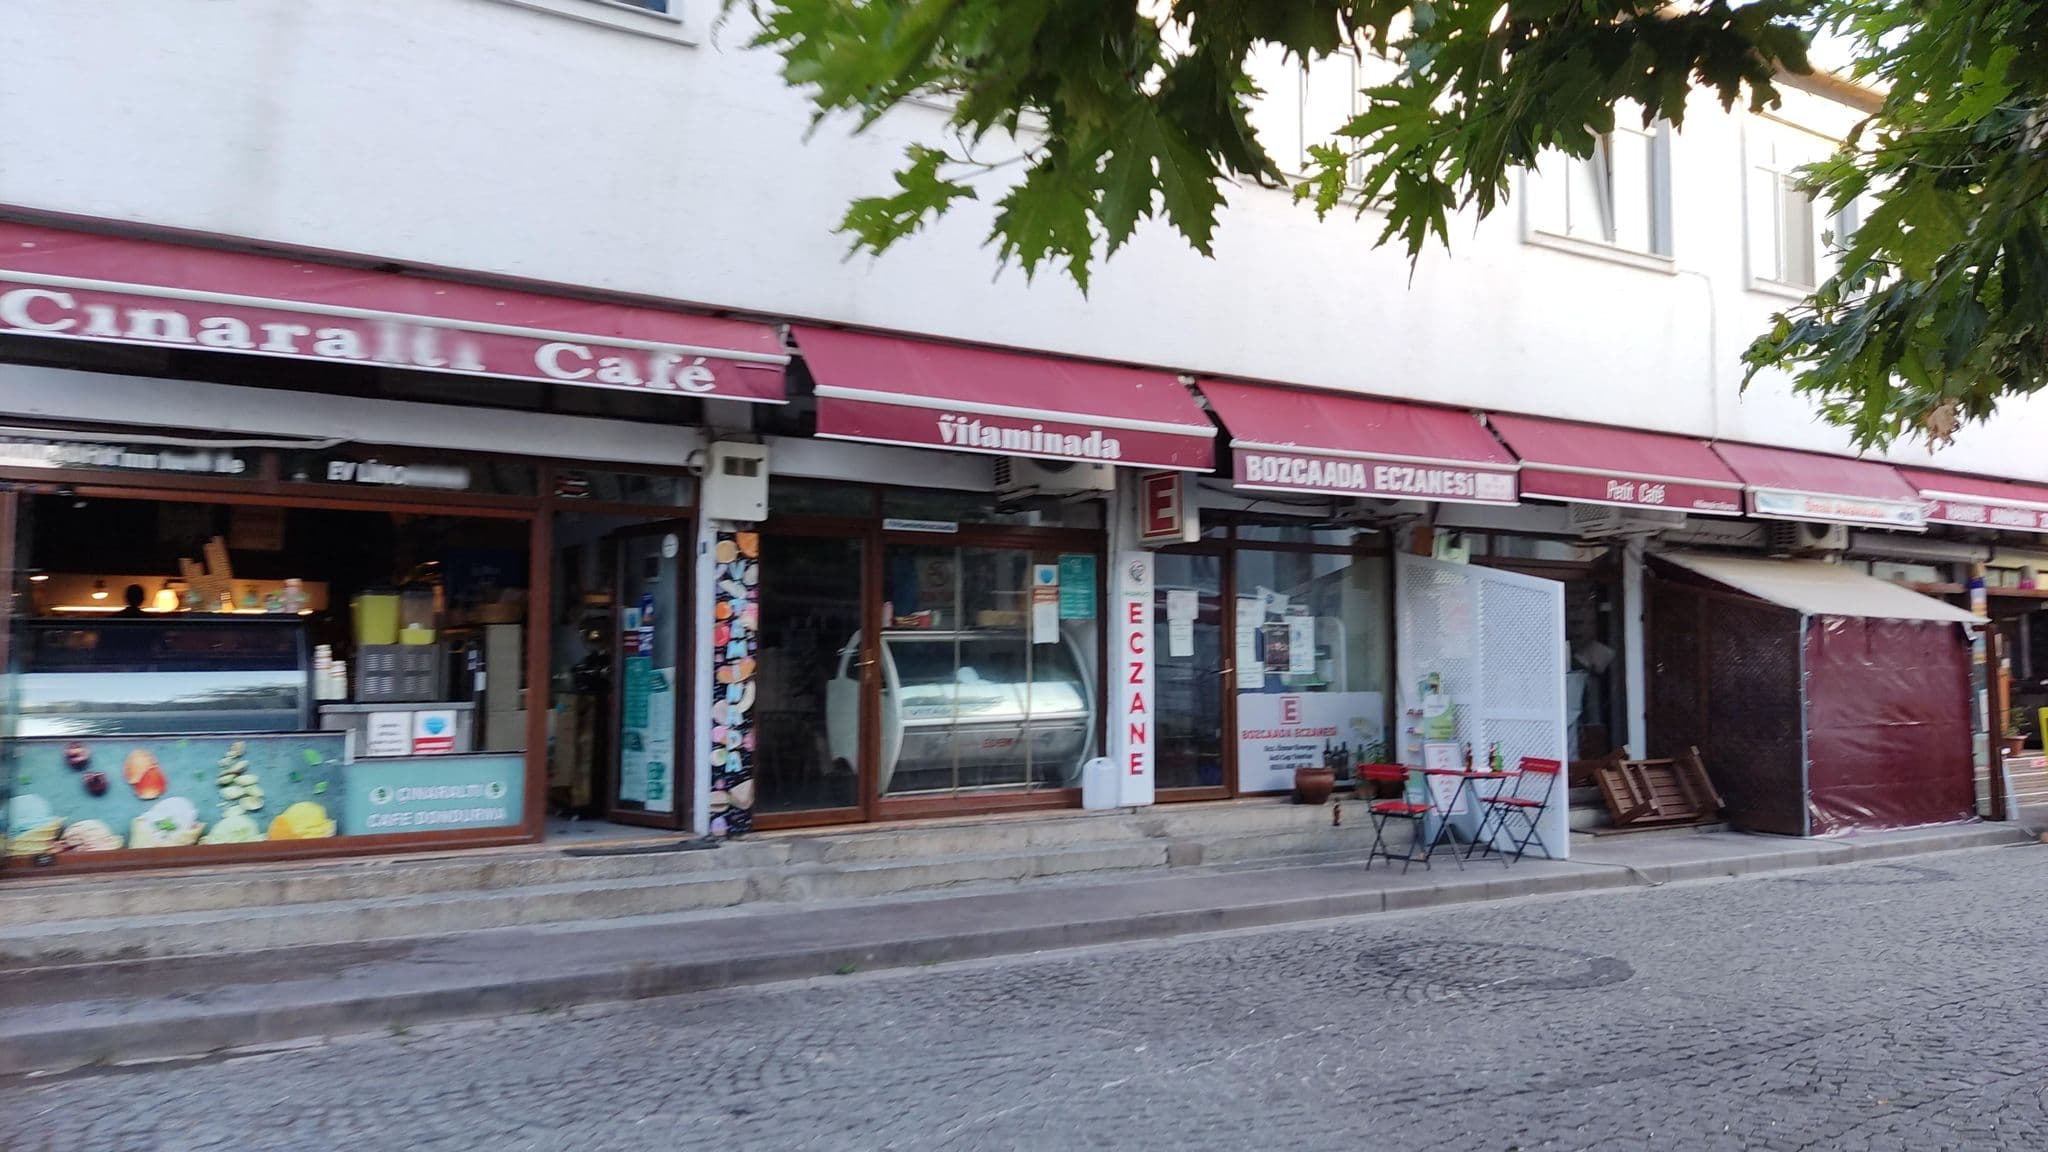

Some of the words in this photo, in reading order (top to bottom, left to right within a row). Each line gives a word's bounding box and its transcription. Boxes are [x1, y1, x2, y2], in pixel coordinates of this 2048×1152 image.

[535, 342, 716, 392] Café
[1246, 455, 1367, 489] BOZCAADA
[1149, 477, 1175, 532] E
[1128, 602, 1145, 776] ECZANE
[1284, 700, 1297, 721] E
